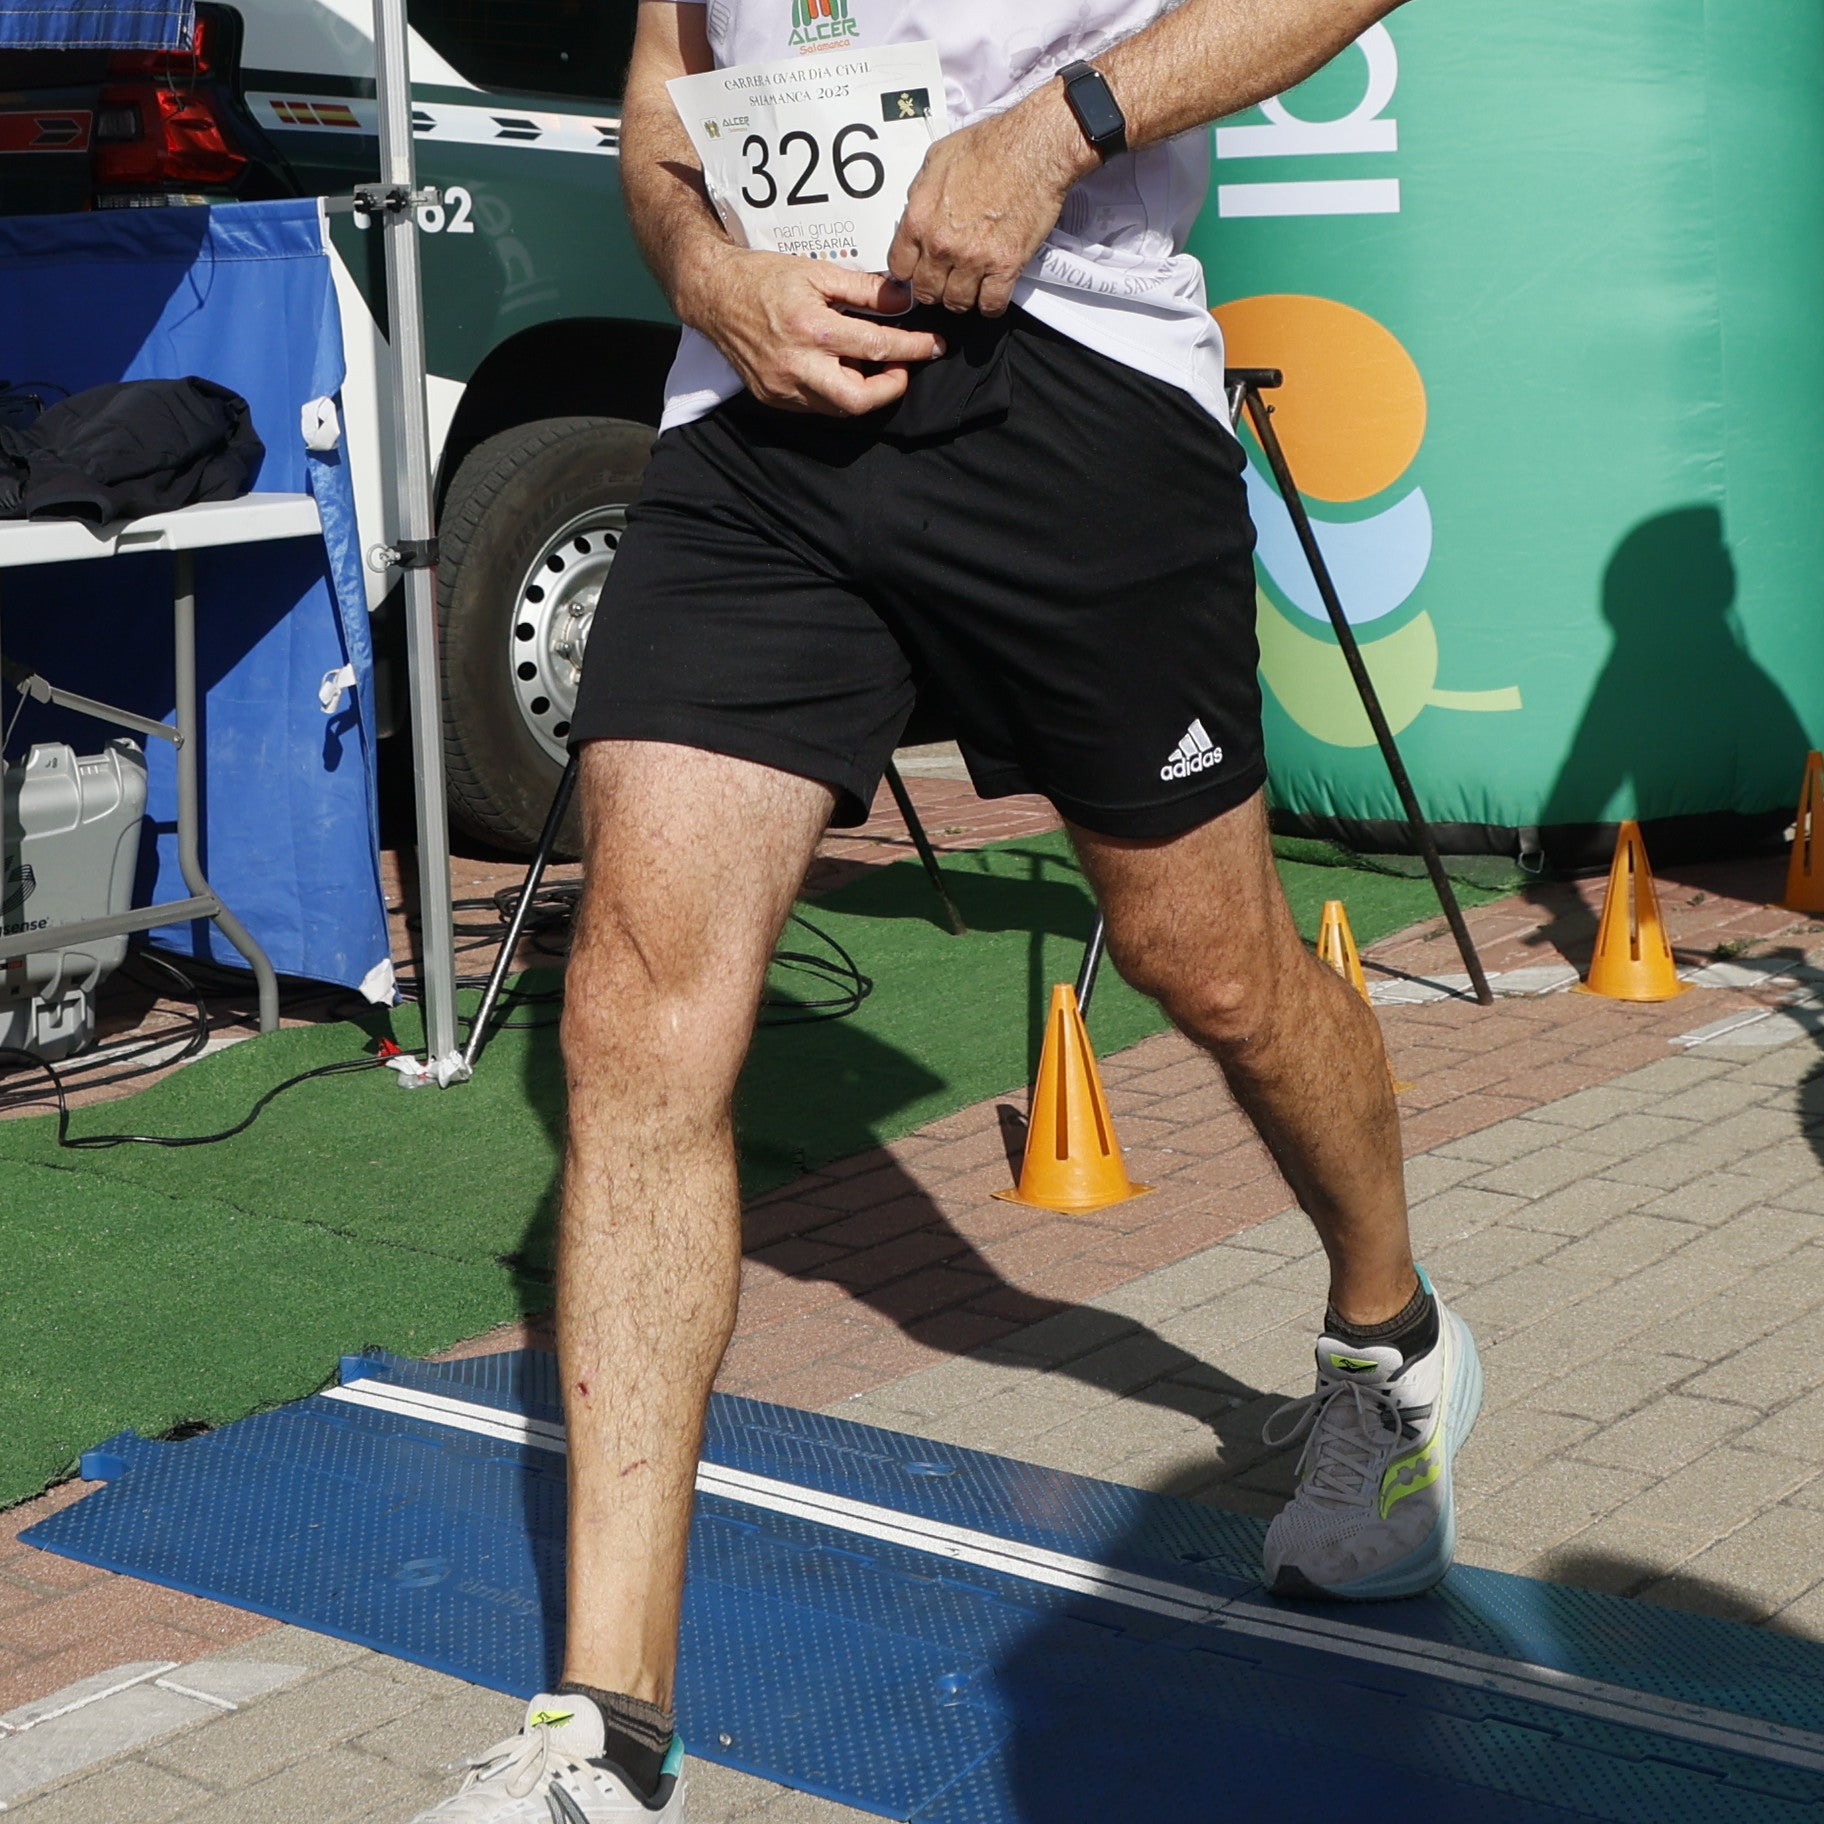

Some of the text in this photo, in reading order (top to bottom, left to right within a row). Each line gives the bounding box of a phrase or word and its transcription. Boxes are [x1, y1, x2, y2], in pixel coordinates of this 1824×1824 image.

[788, 17, 860, 47] ALCER
[799, 38, 851, 56] Salamanca
[724, 74, 772, 91] CARRERA
[749, 84, 850, 107] SALAMANCA 2025
[741, 122, 885, 210] 326
[773, 220, 856, 240] nani grupo
[777, 236, 858, 253] EMPRESARIAL
[1160, 746, 1223, 782] adidas
